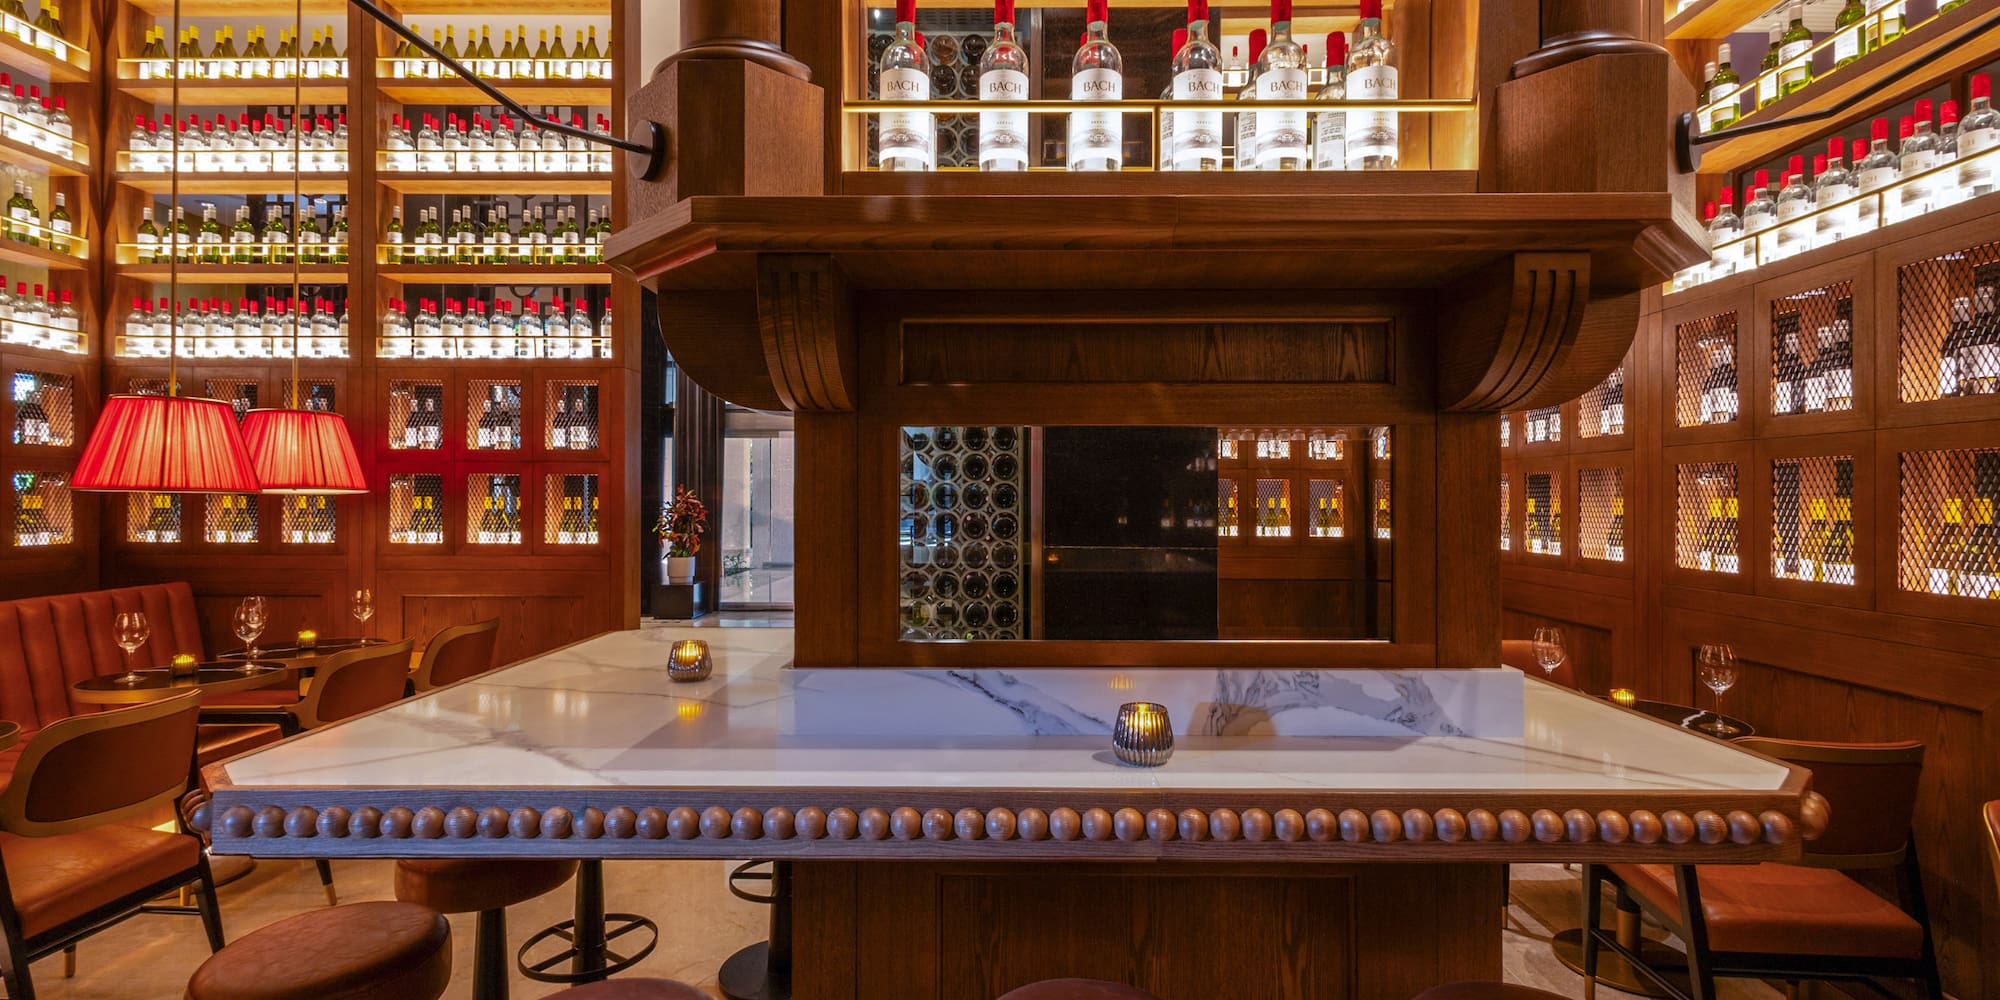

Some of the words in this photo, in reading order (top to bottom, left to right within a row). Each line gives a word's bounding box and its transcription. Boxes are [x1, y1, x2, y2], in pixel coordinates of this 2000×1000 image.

[888, 80, 919, 93] BACH
[989, 81, 1022, 94] BACH
[1083, 80, 1115, 93] BACH
[1188, 80, 1220, 94] BACH
[1270, 80, 1302, 92] BACH
[1364, 78, 1396, 89] BACH
